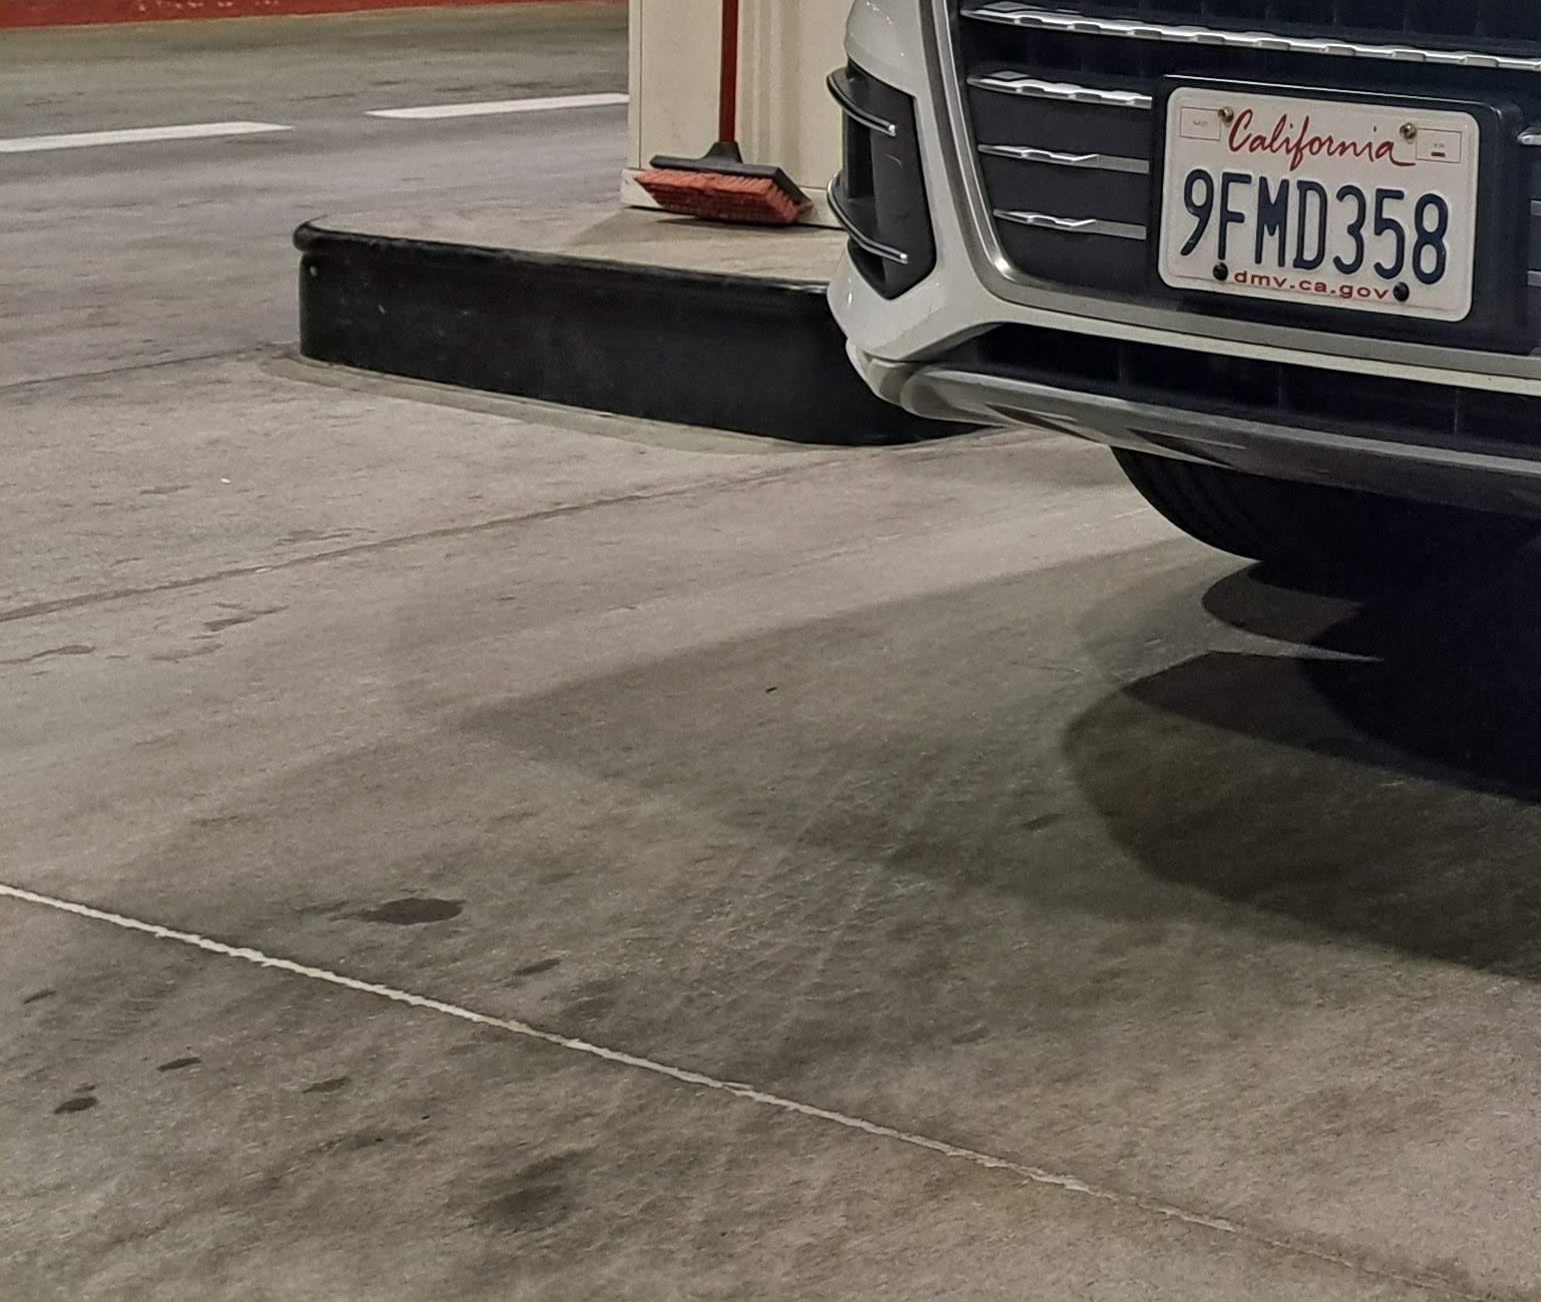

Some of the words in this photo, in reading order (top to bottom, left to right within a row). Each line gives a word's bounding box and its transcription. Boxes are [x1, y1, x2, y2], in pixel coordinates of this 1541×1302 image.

[1229, 108, 1416, 172] California
[1179, 168, 1450, 286] 9FMD358
[1233, 269, 1390, 300] dmv.ca.gov
